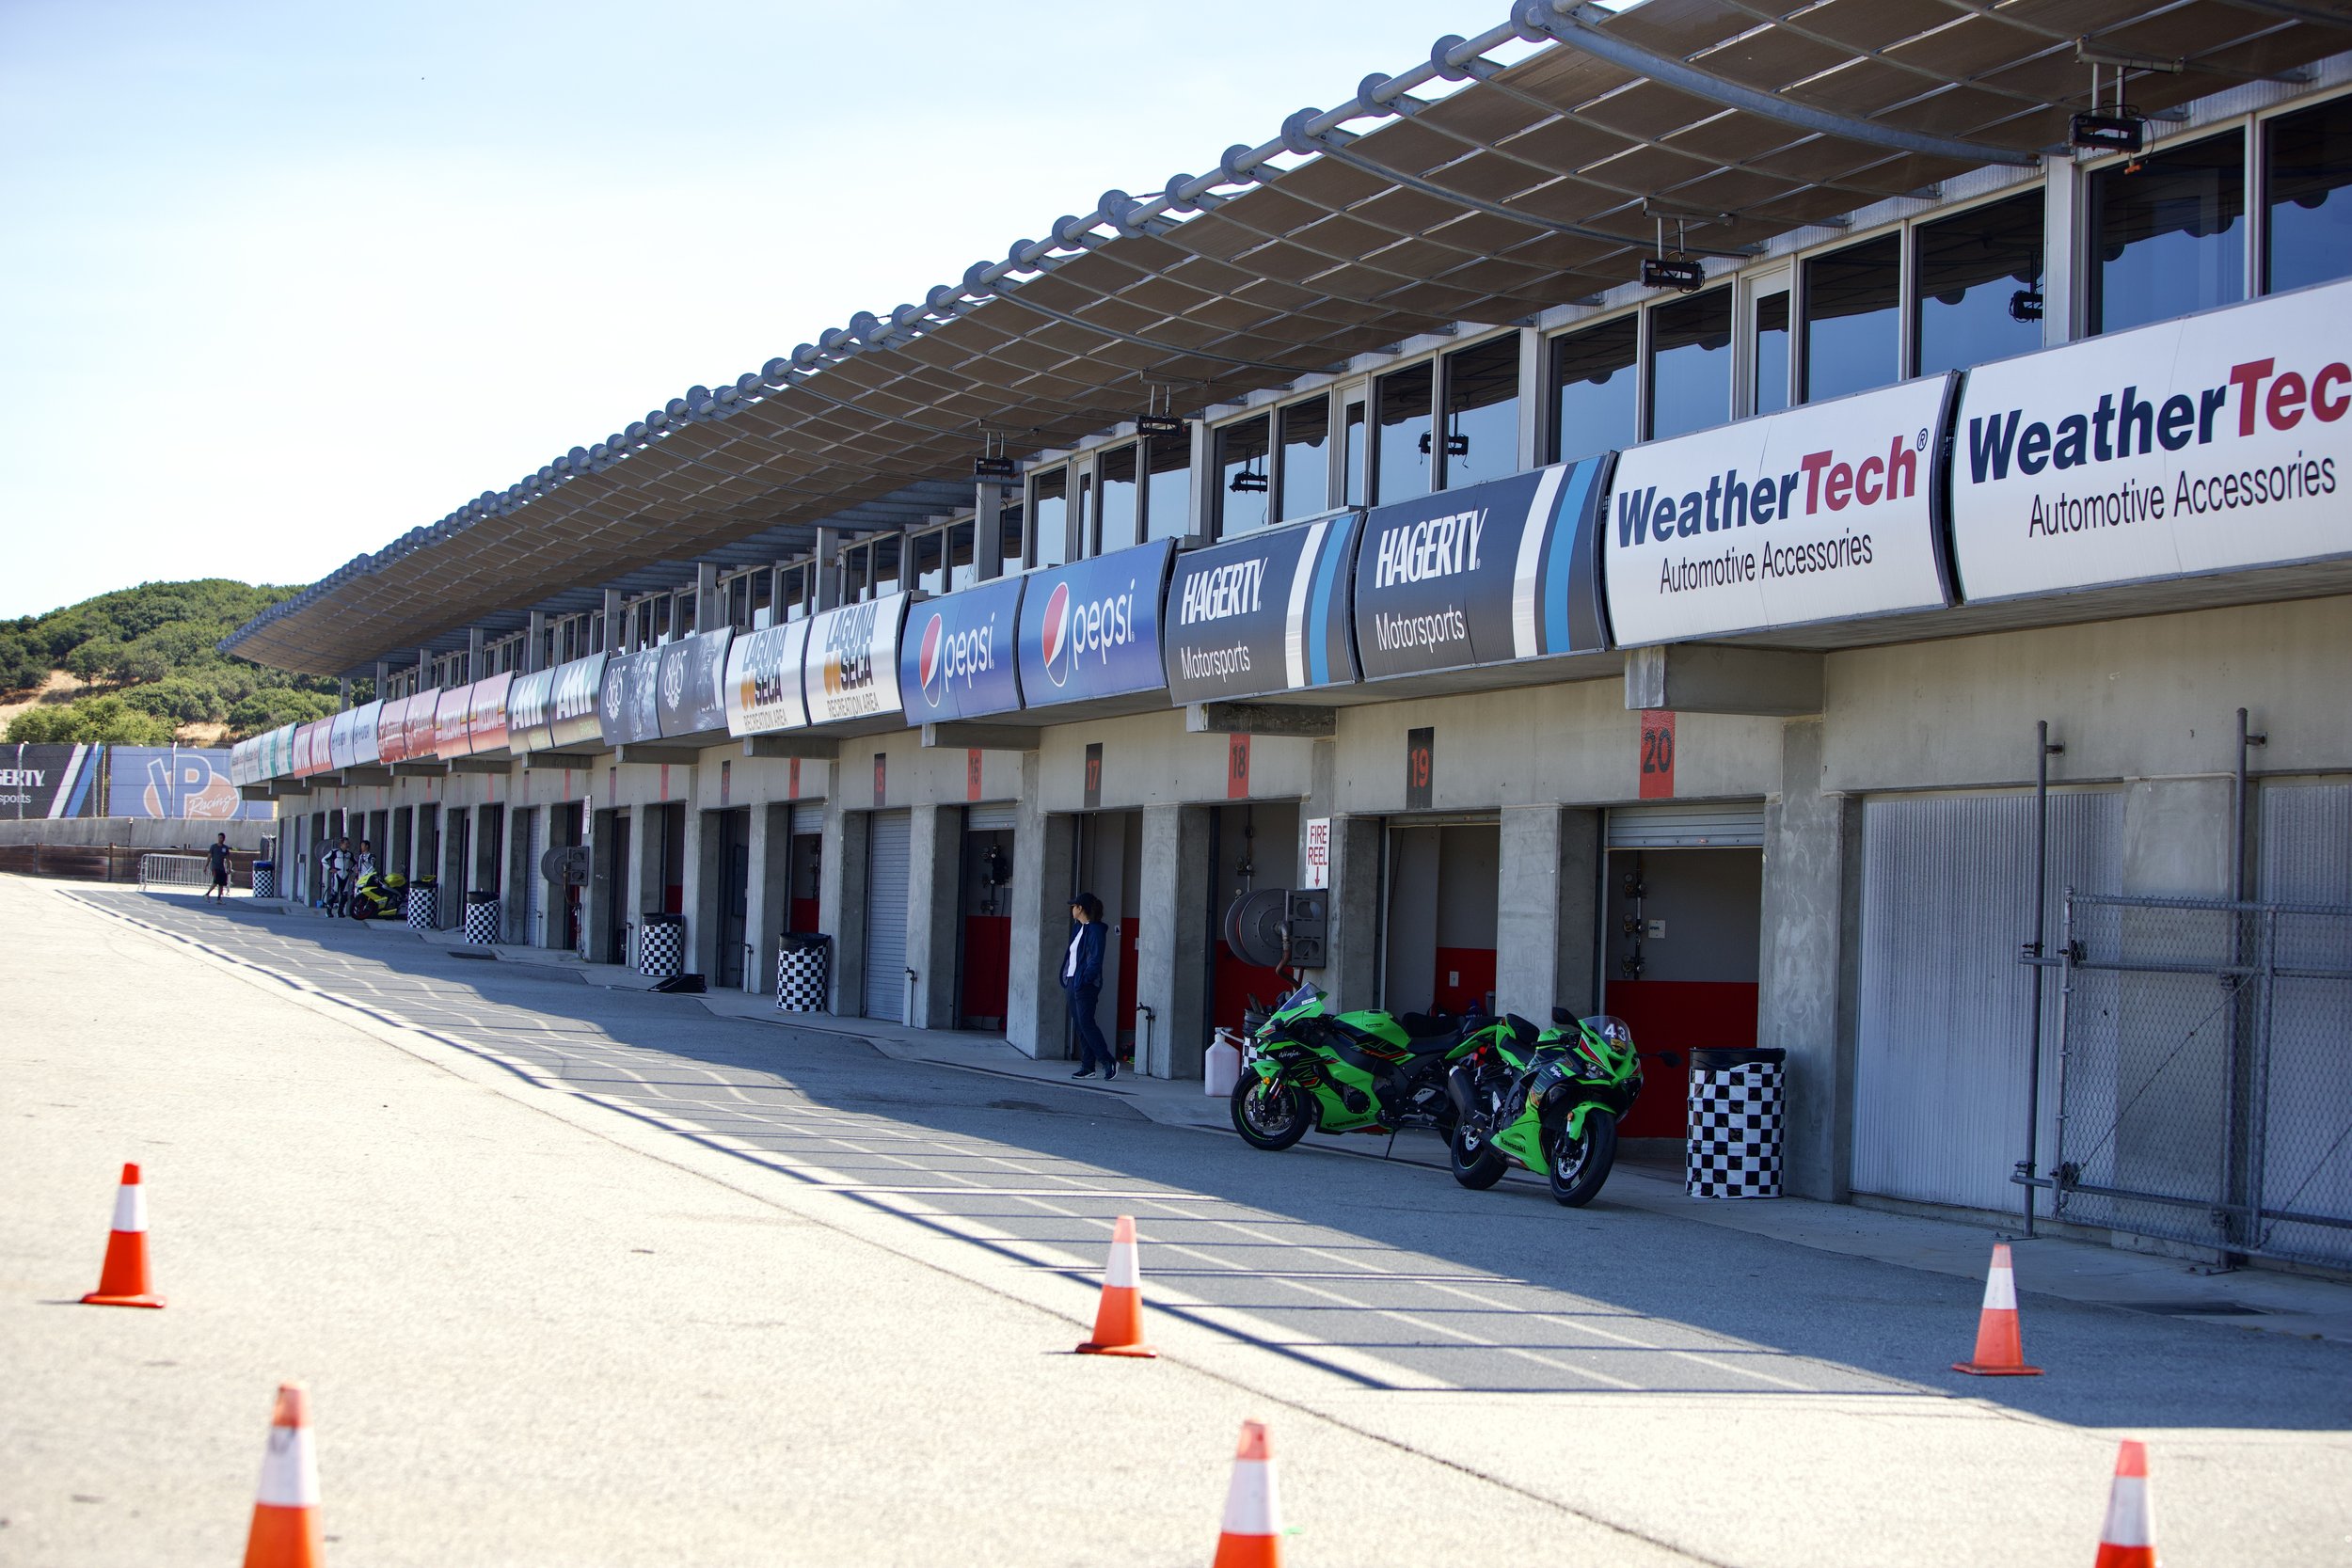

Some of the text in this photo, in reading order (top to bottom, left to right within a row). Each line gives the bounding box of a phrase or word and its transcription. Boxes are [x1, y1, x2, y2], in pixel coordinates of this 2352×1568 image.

[1969, 357, 2352, 483] WeatherTec
[2029, 451, 2336, 538] Automotive Accessories
[1661, 528, 1873, 594] Automotive Accessories
[825, 602, 879, 653] LAGUNA
[1073, 578, 1136, 670] pepsi
[1375, 604, 1466, 653] Motorsports
[741, 626, 787, 673] LAGUNA
[840, 642, 874, 690] SECA
[945, 612, 995, 692] pepsi
[1180, 641, 1250, 683] Motorsports
[755, 663, 783, 706] SECA
[773, 708, 788, 727] AREA
[827, 692, 880, 718] RECREATION AREA
[1233, 744, 1246, 779] 18
[1411, 748, 1429, 787] 19
[1643, 727, 1672, 774] 20
[971, 757, 979, 784] 16
[1088, 760, 1099, 790] 17
[188, 794, 237, 819] Racing
[1310, 825, 1327, 845] FIRE
[1308, 846, 1327, 865] REEL
[1604, 1022, 1627, 1042] 43
[1279, 1050, 1301, 1058] Ninja
[1326, 1116, 1369, 1128] Kawasaki
[1501, 1137, 1526, 1153] Kawasaki
